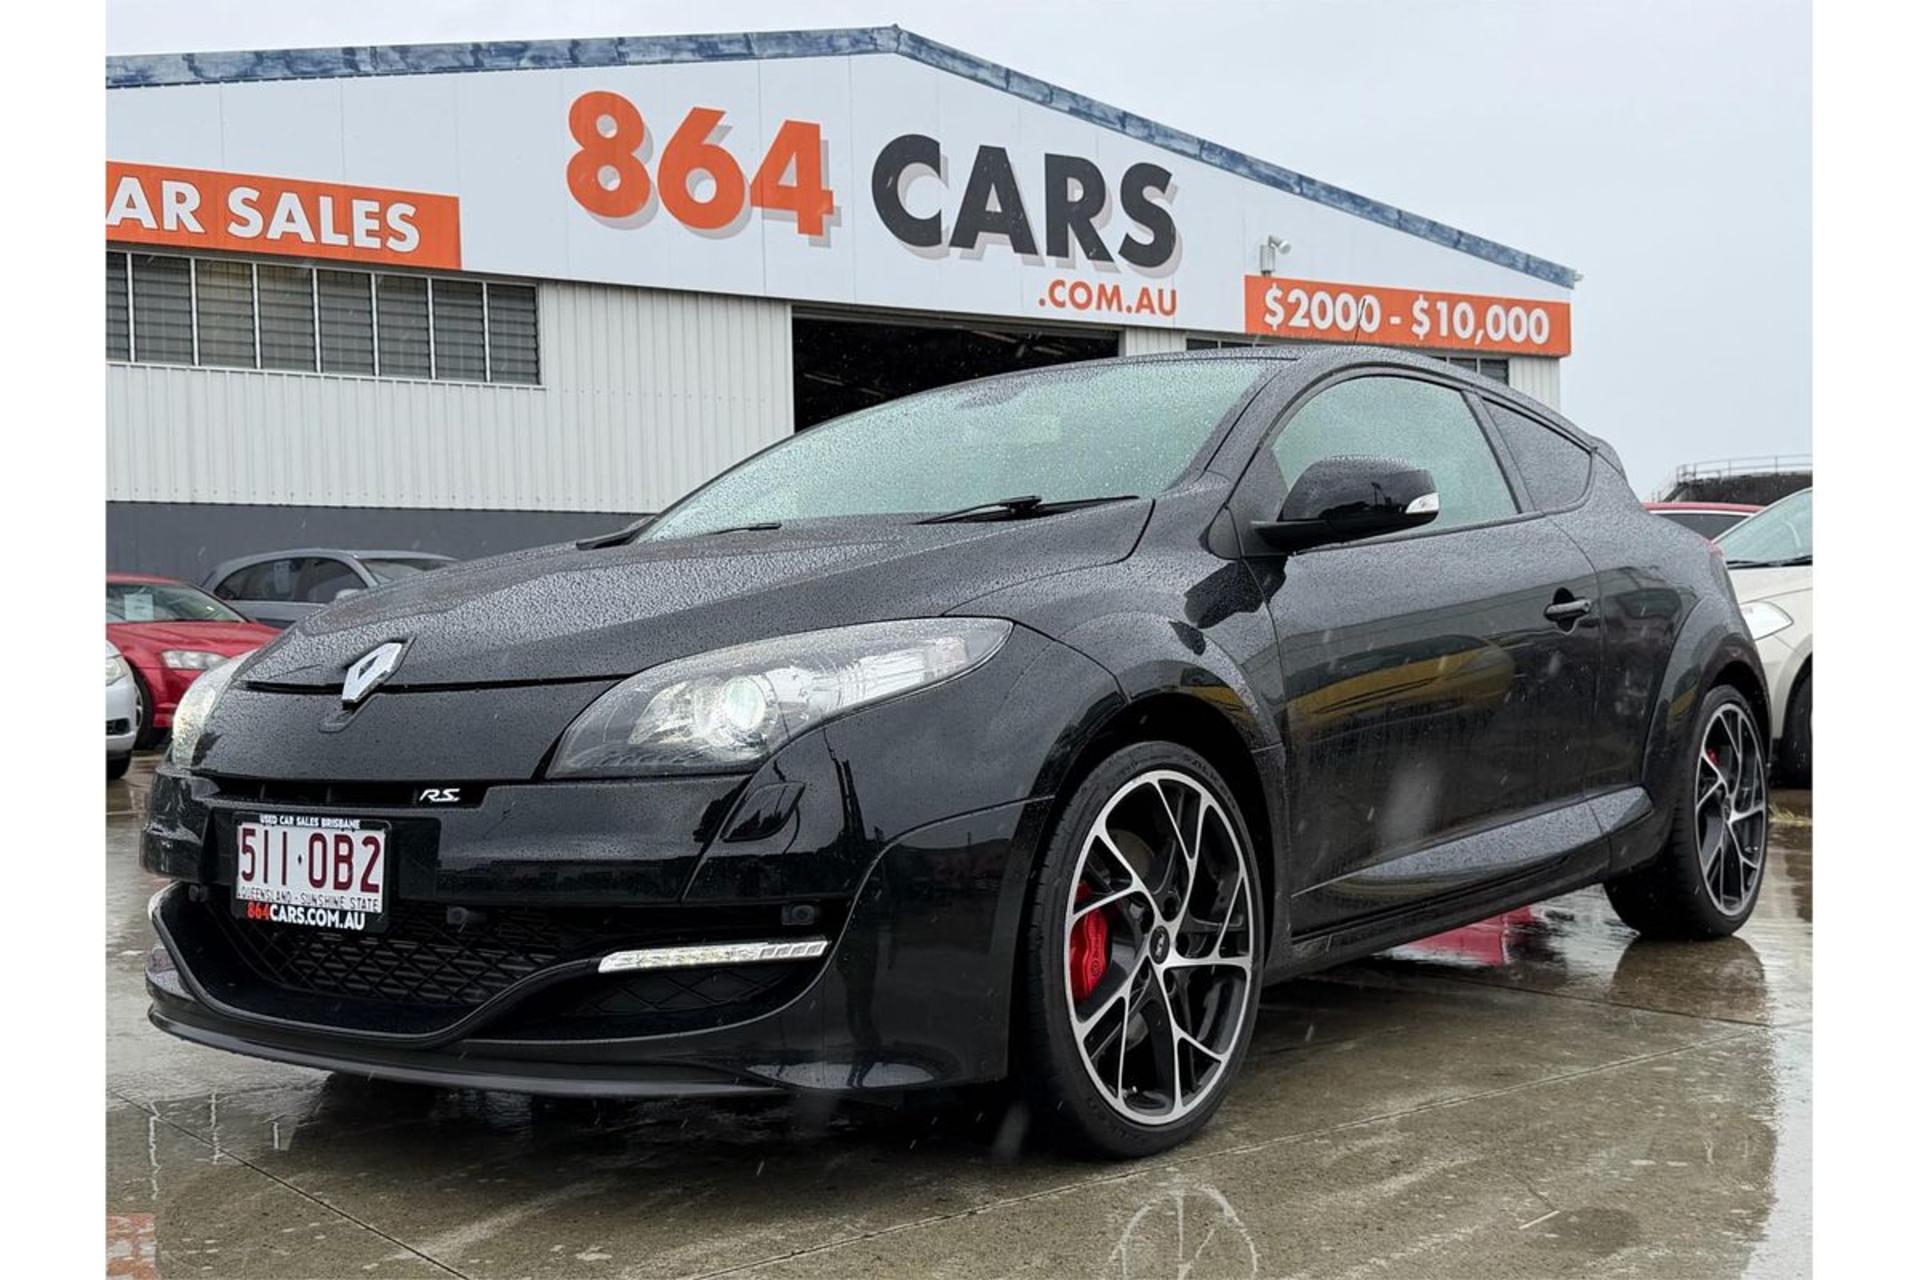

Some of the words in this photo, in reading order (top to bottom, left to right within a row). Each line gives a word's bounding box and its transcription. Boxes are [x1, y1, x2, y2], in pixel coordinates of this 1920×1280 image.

[566, 90, 833, 236] 864
[871, 133, 1177, 268] CARS
[227, 187, 420, 252] SALES
[1038, 279, 1177, 316] .COM.AU
[1263, 283, 1381, 333] $2000
[1411, 294, 1550, 344] $10,000
[259, 814, 278, 825] USED
[280, 816, 294, 825] CAR
[296, 816, 320, 828] SALES
[321, 818, 361, 830] BRISBANE
[247, 902, 365, 930] 864CARS.COM.AU
[300, 892, 345, 908] SUNSHINE
[350, 897, 379, 911] STATE
